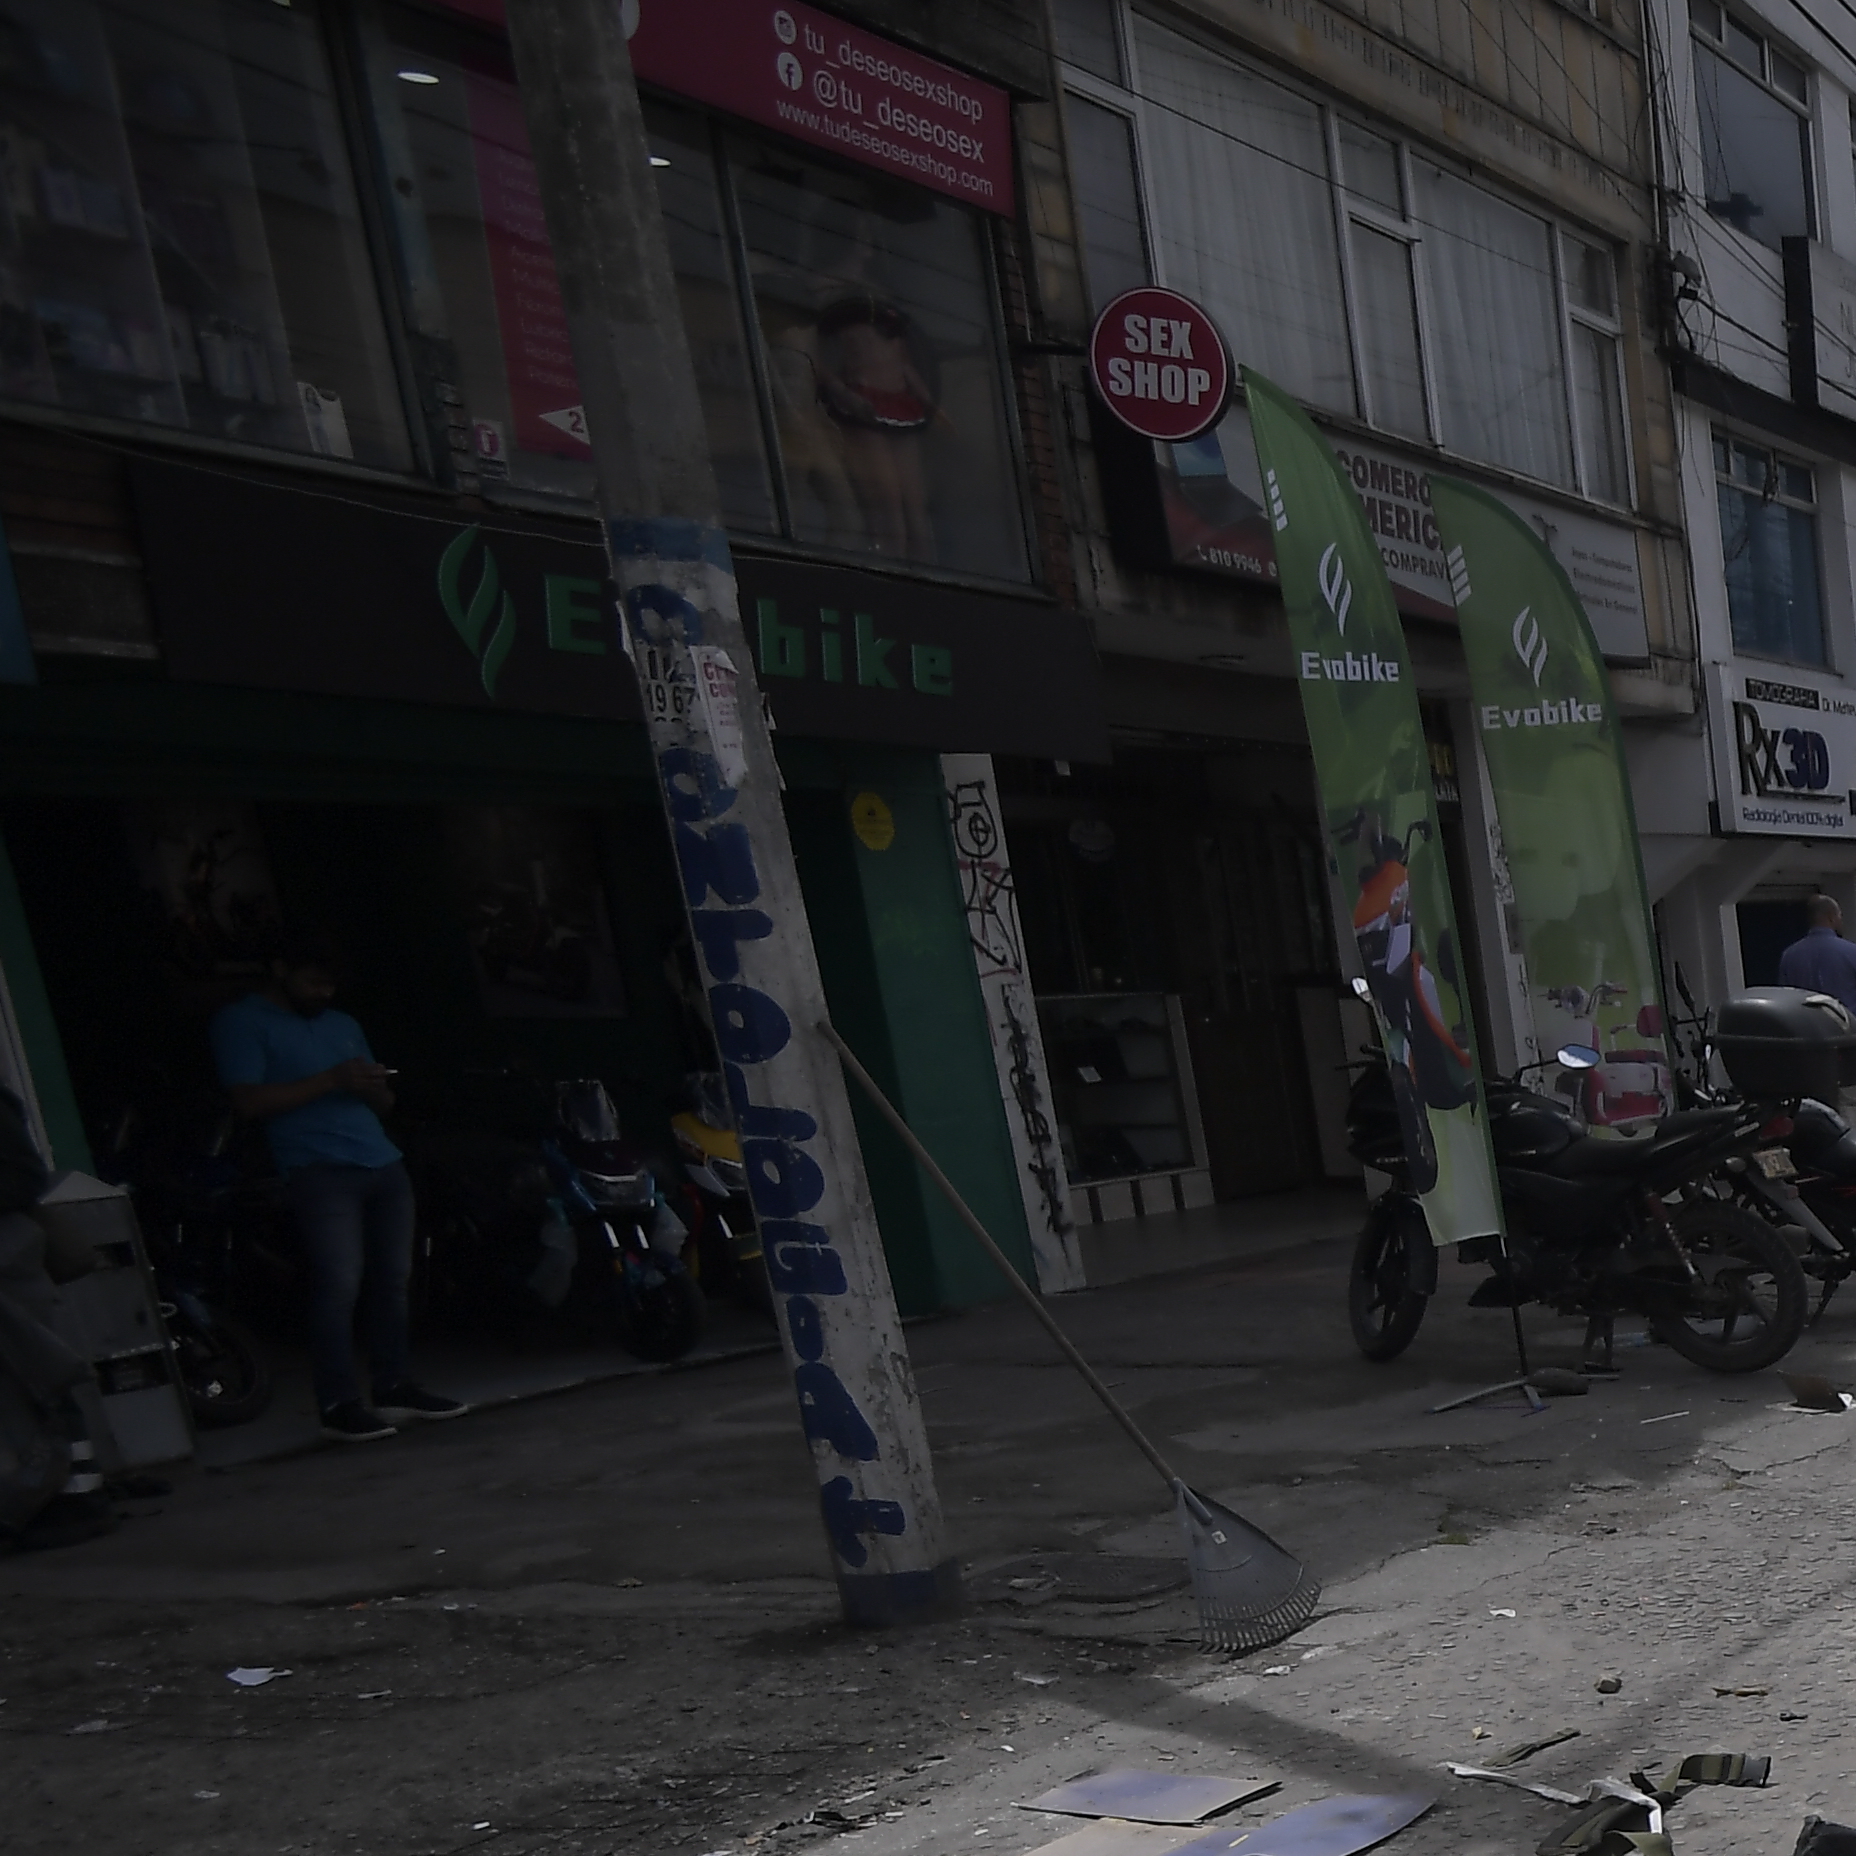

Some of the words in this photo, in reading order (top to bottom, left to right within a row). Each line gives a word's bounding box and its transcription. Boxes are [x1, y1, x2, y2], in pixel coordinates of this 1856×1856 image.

[804, 23, 983, 124] tu_deseosexshop
[777, 100, 994, 196] www.tudeseosexshop.com
[814, 69, 985, 163] @tu_deseosex
[1124, 314, 1194, 360] SEX
[1108, 357, 1211, 406] SHOP
[543, 573, 953, 697] Ebike
[1300, 650, 1400, 684] Evobike
[1481, 697, 1603, 731] Evobike
